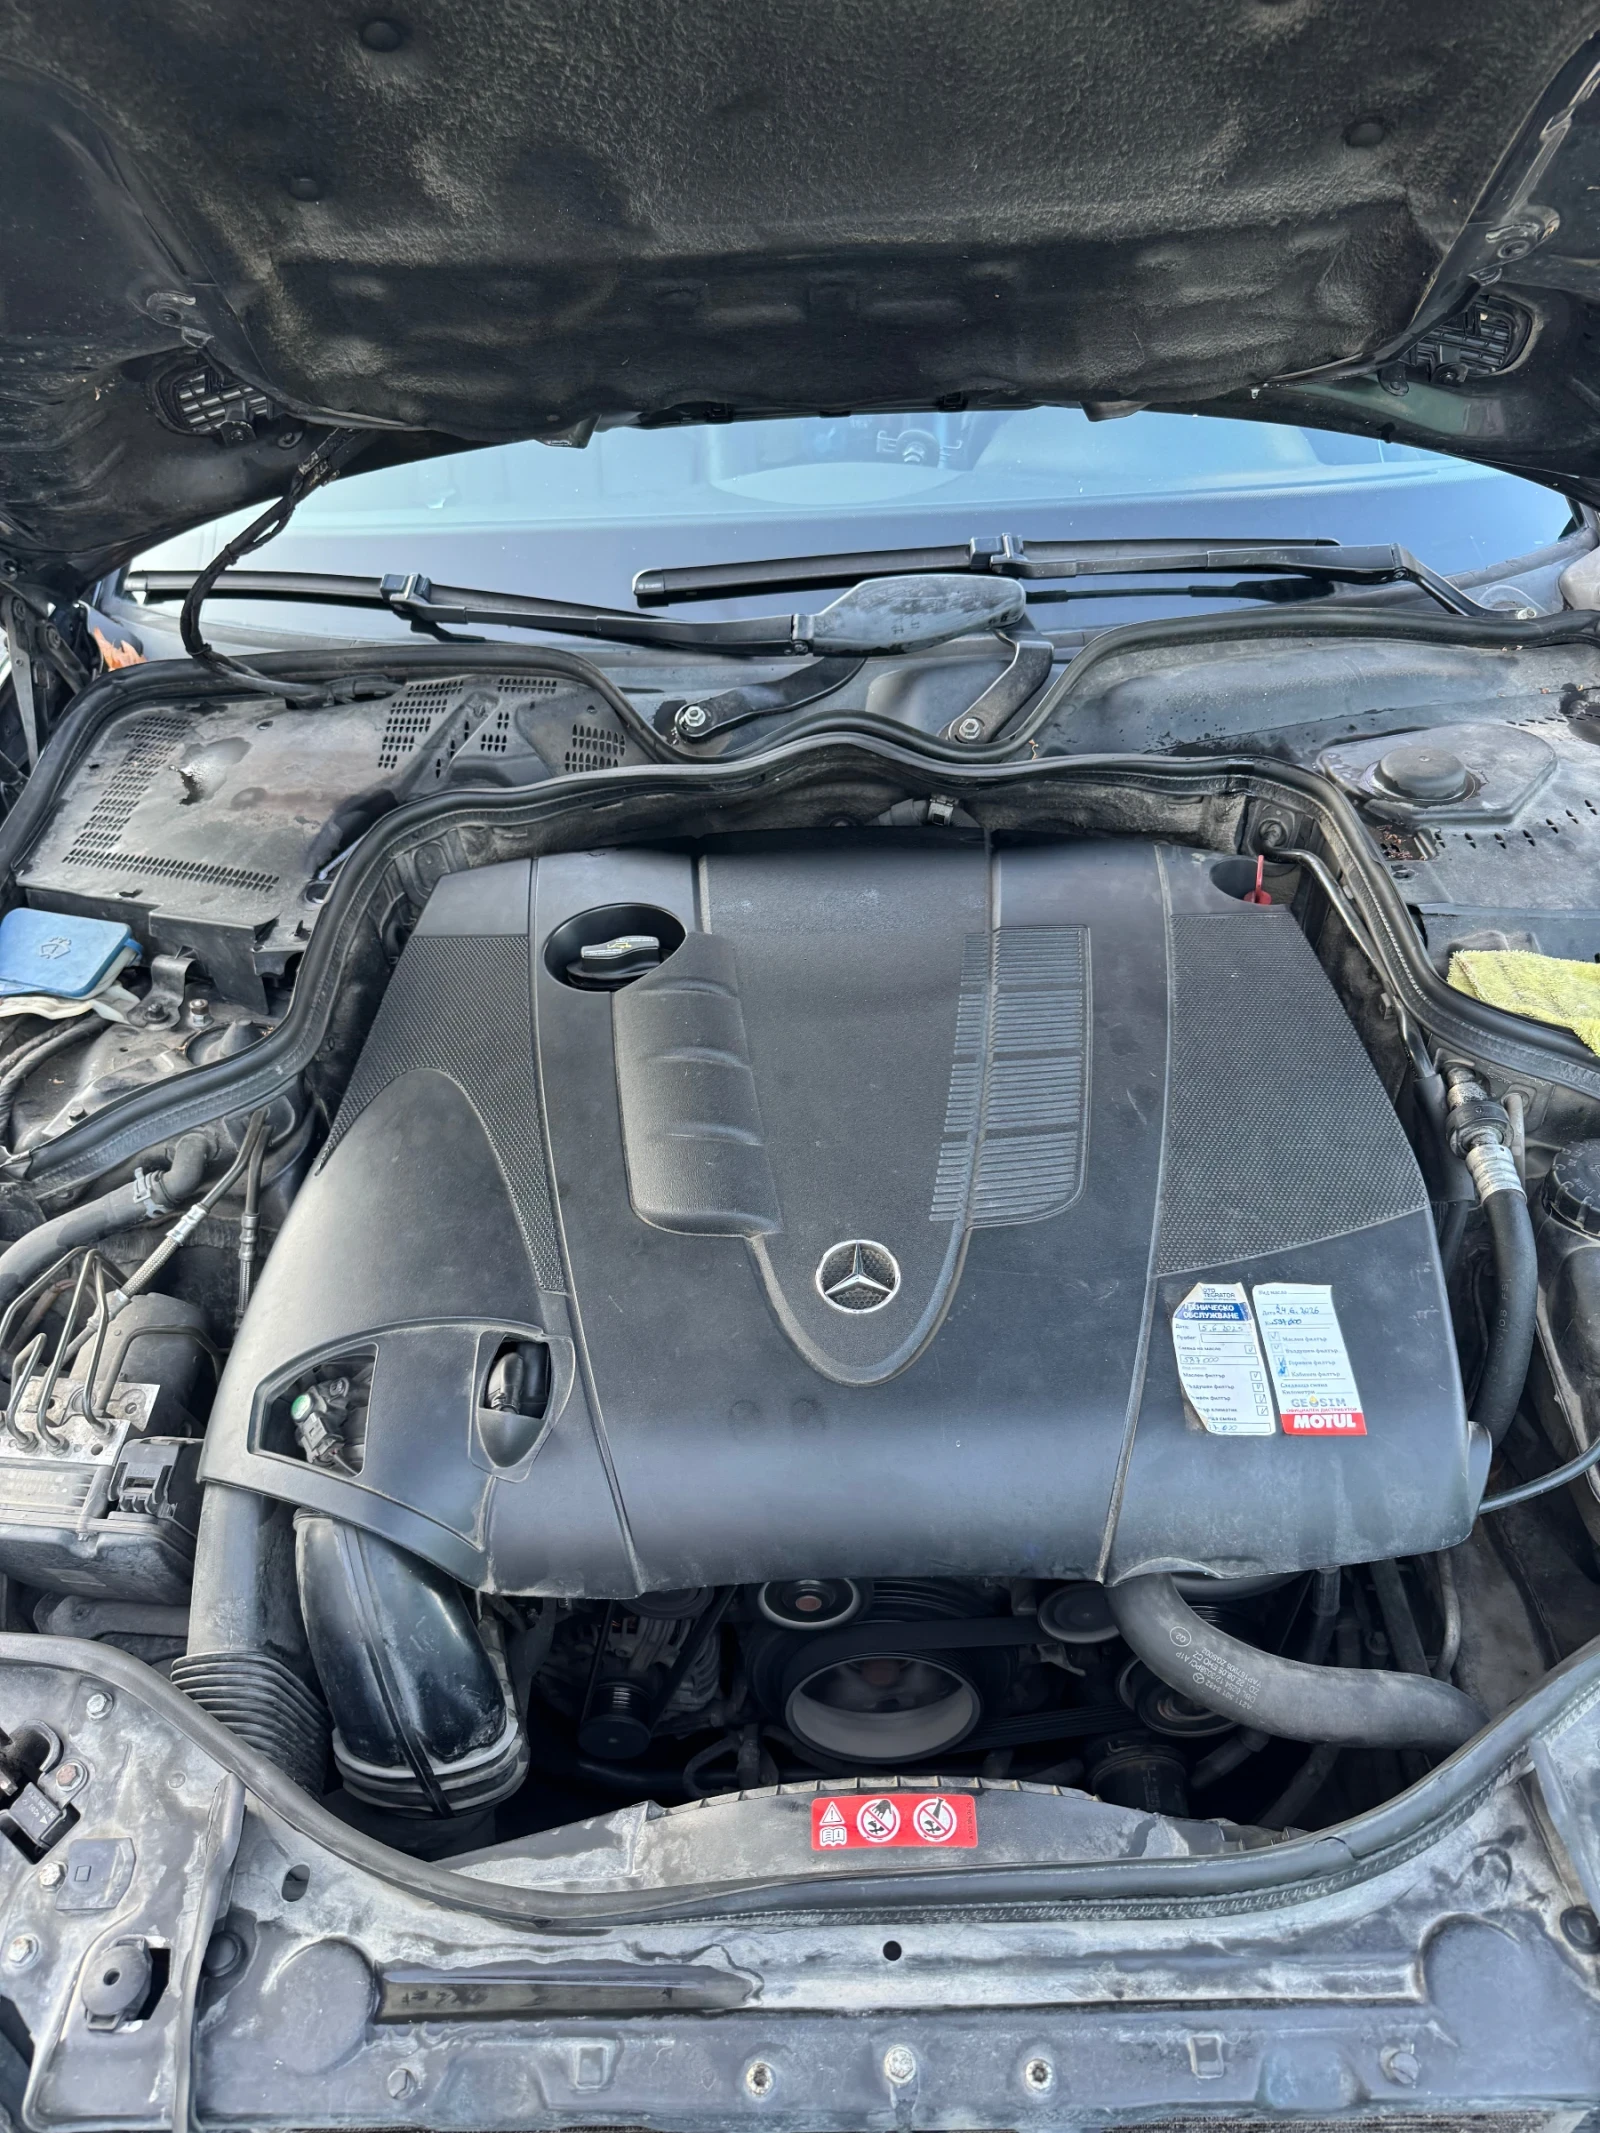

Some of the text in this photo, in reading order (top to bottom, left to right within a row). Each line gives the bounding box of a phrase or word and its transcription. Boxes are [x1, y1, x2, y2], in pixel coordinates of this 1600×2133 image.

[1183, 1311, 1240, 1320] ОБСЛУЖВАНЕ
[1291, 1396, 1347, 1408] GEOSIM
[1293, 1414, 1356, 1428] MOTUL
[1175, 1633, 1186, 1643] Q2
[1192, 1650, 1204, 1660] CZ
